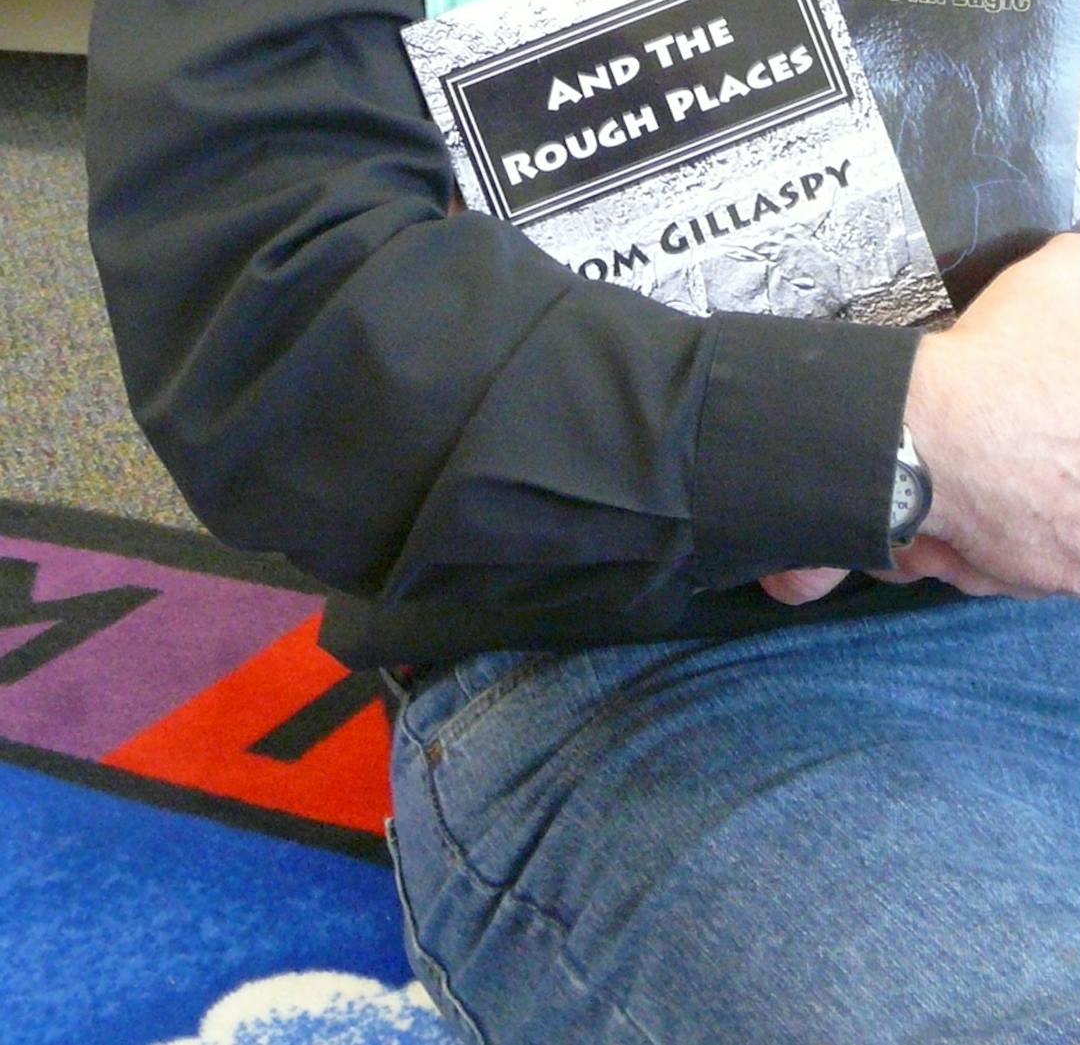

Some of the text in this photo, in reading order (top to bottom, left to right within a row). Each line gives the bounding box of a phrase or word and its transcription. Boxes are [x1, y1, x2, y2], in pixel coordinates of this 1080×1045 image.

[499, 44, 814, 186] ROUGH PLACES
[548, 16, 735, 111] AND THE
[567, 159, 852, 281] OM GILLASPY
